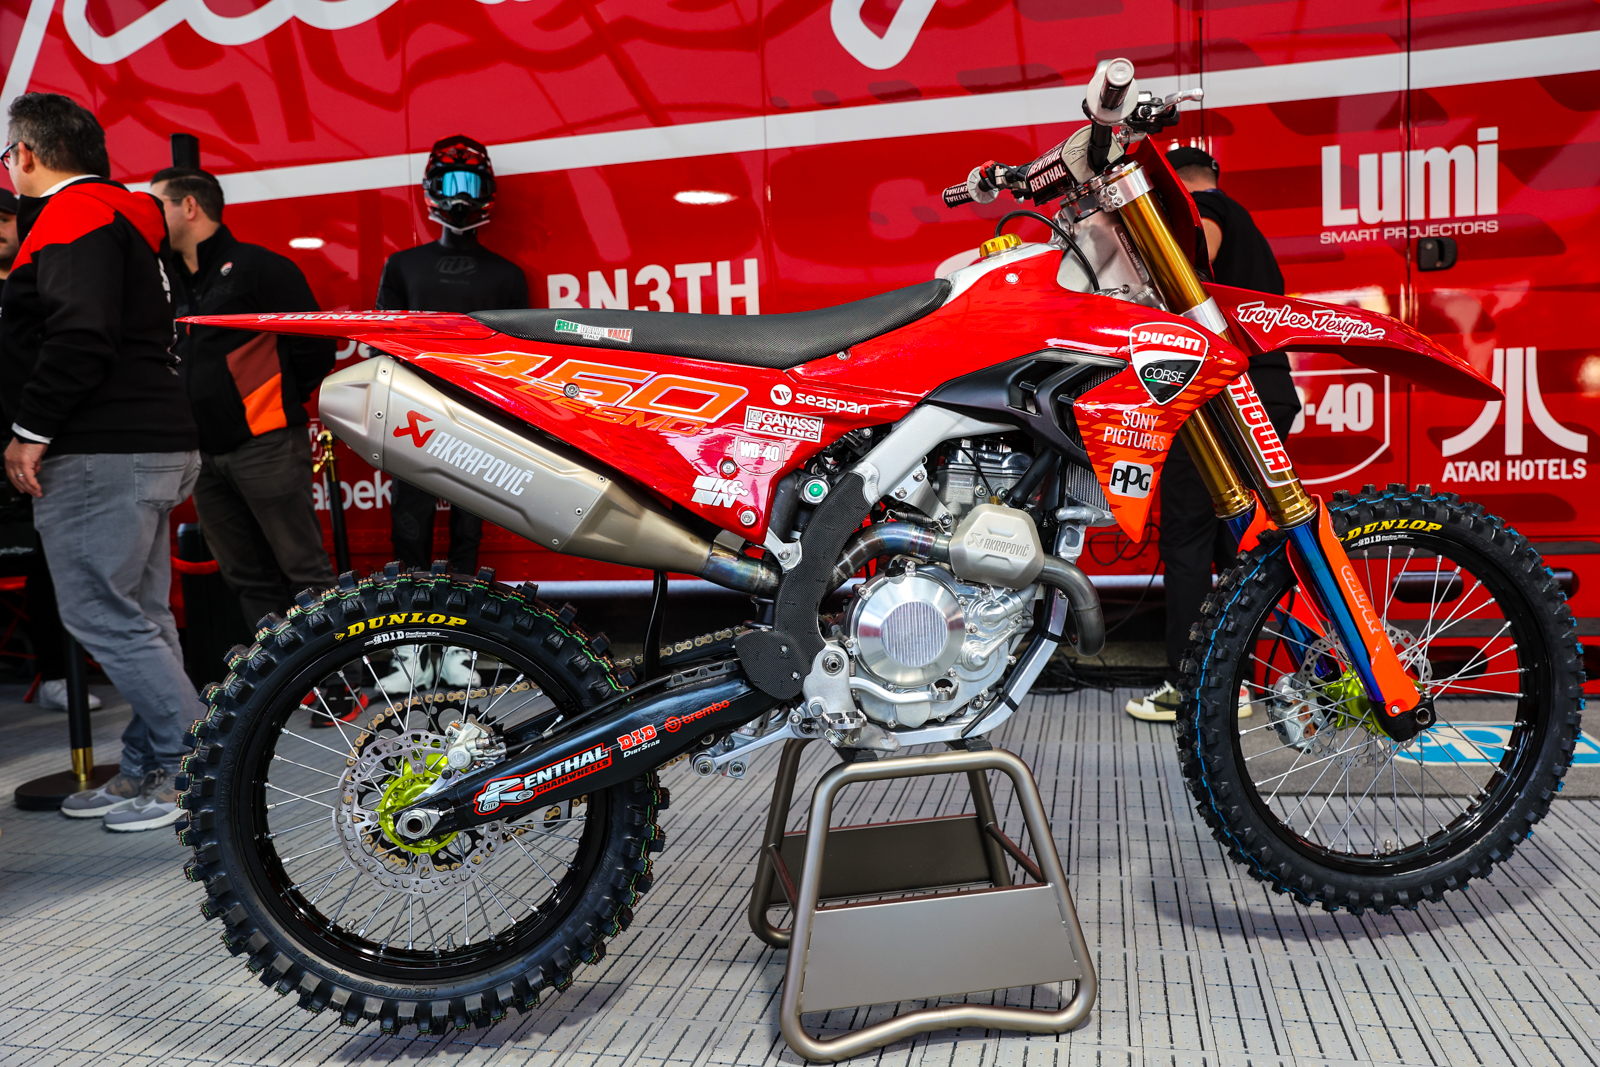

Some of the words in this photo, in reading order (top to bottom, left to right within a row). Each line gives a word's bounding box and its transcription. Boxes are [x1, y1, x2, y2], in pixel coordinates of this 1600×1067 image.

[1029, 164, 1067, 193] RENTHAL
[1322, 126, 1498, 227] Lumi
[945, 184, 969, 196] ENTHAL
[1320, 228, 1381, 244] SMART
[1384, 220, 1499, 240] PROJECTORS
[547, 258, 760, 316] BN3TH
[279, 312, 407, 321] DUNLOP
[1237, 301, 1281, 333] Troy
[1276, 305, 1311, 329] Lee
[1312, 309, 1386, 344] Designs
[556, 320, 579, 333] SELLE
[608, 328, 631, 341] VALLE
[1137, 331, 1201, 351] DUCATI
[415, 350, 749, 423] 450
[1144, 366, 1186, 384] CORSE
[514, 384, 708, 437] DESMO
[795, 392, 869, 416] seaspan
[746, 422, 819, 440] RACING
[761, 411, 820, 432] GANASSI
[1121, 410, 1159, 431] SONY
[740, 441, 780, 462] WD-40
[1103, 426, 1166, 452] PICTURES
[426, 431, 535, 497] AKRAPOVIČ
[1441, 460, 1500, 483] ATARI
[1506, 458, 1587, 481] HOTELS
[1110, 465, 1152, 494] PPG
[1345, 519, 1443, 542] DUNLOP
[983, 538, 1030, 557] AKRAPOVIČ
[347, 612, 467, 637] DUNLOP
[681, 699, 730, 725] brembo
[617, 724, 658, 751] D.I.D
[536, 759, 610, 793] CHAINWHEELS
